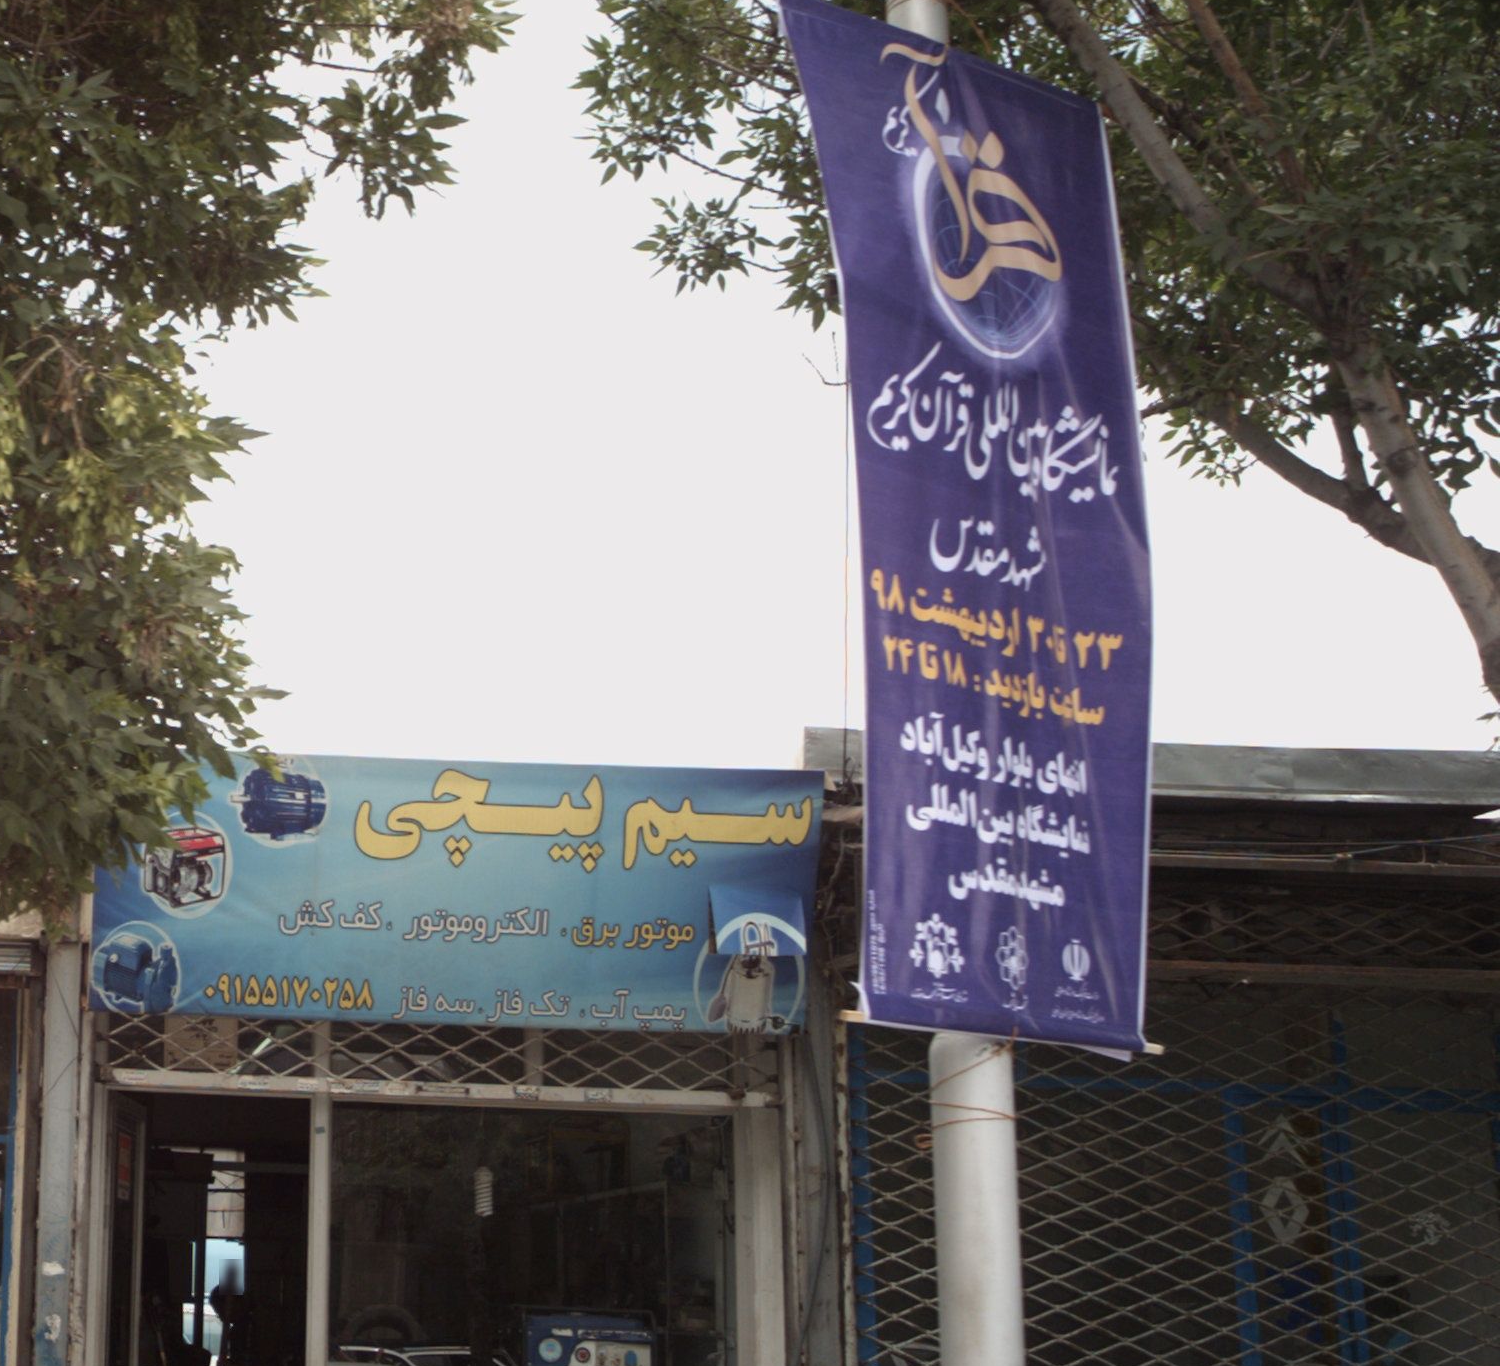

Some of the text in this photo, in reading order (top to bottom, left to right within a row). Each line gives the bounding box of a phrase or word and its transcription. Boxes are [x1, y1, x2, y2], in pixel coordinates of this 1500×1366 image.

[866, 341, 943, 452] کریم
[909, 370, 975, 452] قرآن
[929, 516, 1047, 592] شهد مقدس
[870, 567, 905, 615] ۹۸
[909, 587, 1021, 657] اردیبهشت
[882, 635, 914, 675] ۲۴
[918, 641, 939, 680] تا
[943, 649, 968, 688] ۱۸
[1073, 630, 1124, 671] ۲۳
[900, 711, 1088, 798] انتهای بلوار وکیل آباد
[352, 768, 813, 873] سیم پیچی
[905, 782, 1091, 859] نمایشگاه بین المللی
[947, 857, 1066, 911] مشهد مقدس
[279, 898, 336, 936] کش
[339, 900, 383, 931] کف
[622, 917, 696, 951] موتور
[203, 972, 374, 1011] ۰۹۱۵۵۱۷۰۲۵۸
[392, 985, 429, 1021] فاز
[434, 994, 477, 1015] سه
[528, 990, 572, 1017] تک
[632, 1001, 688, 1032] پمپ
